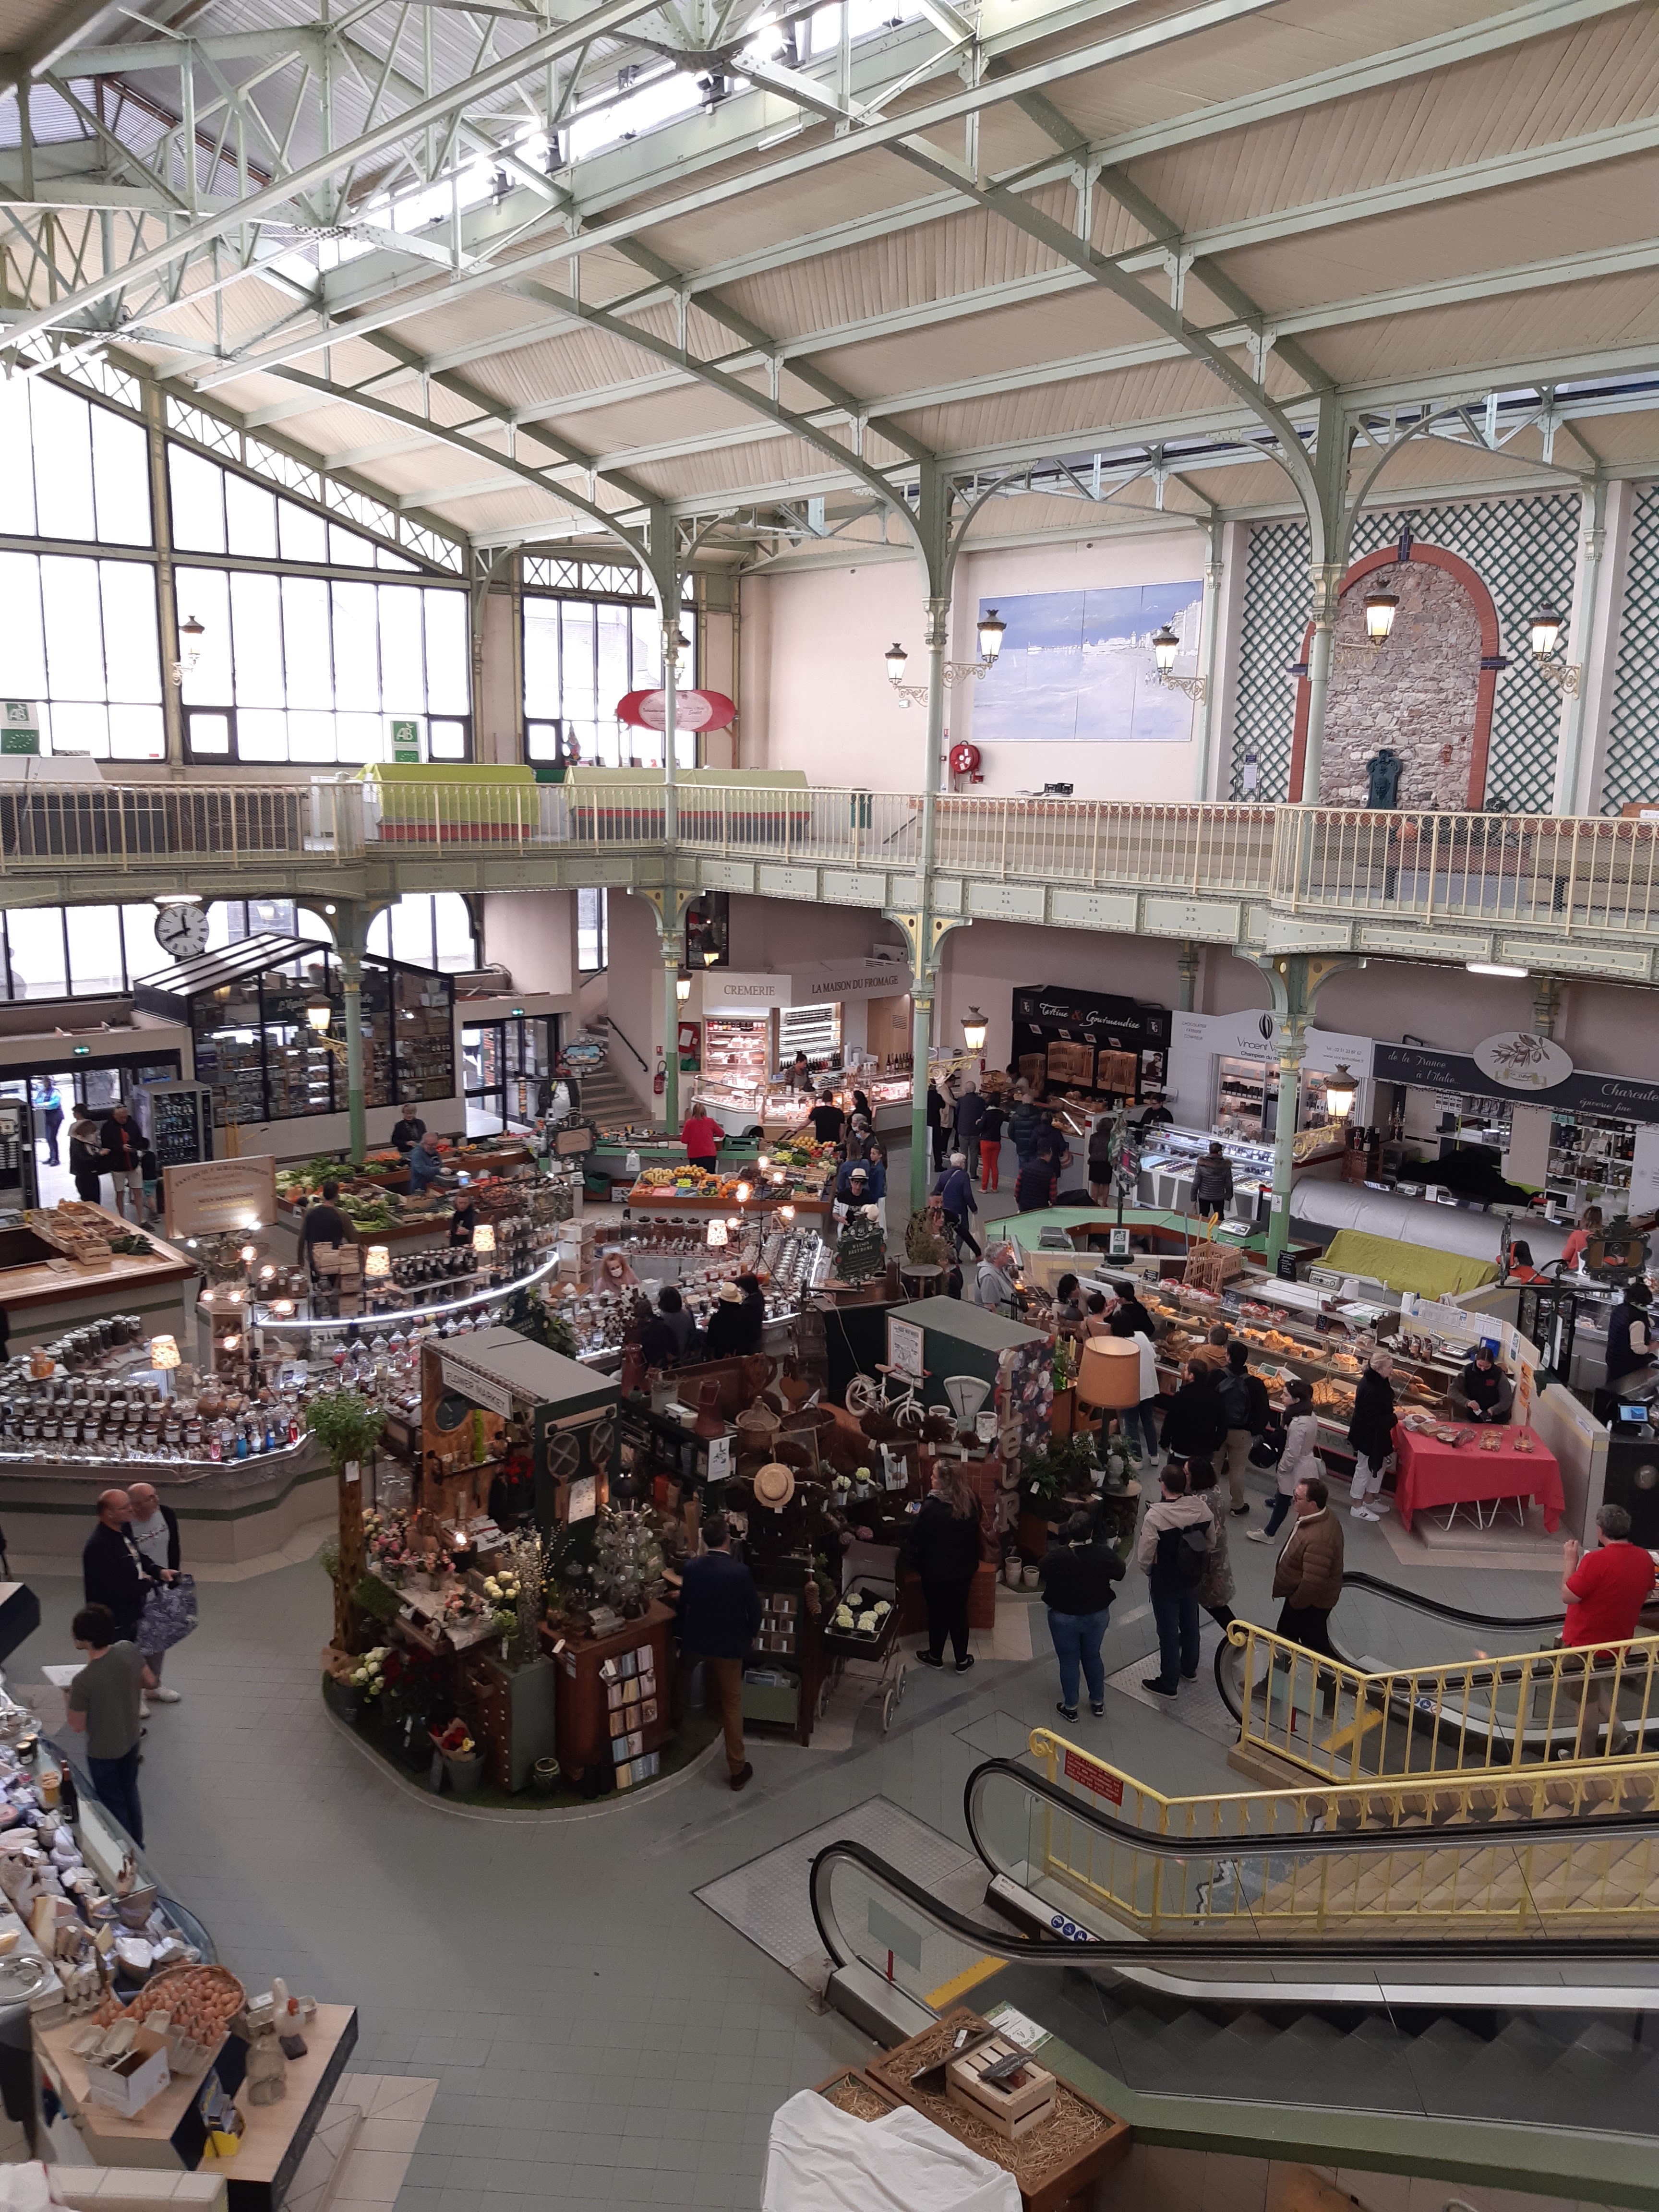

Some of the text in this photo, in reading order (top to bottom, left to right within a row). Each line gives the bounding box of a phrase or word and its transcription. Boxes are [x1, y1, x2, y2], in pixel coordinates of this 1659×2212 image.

[724, 985, 775, 996] CREMERIE
[812, 975, 899, 994] LA MAISON DU FROMAGE
[1039, 1003, 1141, 1029] Tartine & Gourmandise
[1237, 1036, 1267, 1050] Vincent
[1240, 1050, 1265, 1058] Champion
[1388, 1050, 1446, 1068] de la France
[1579, 1098, 1632, 1113] épicerie fine
